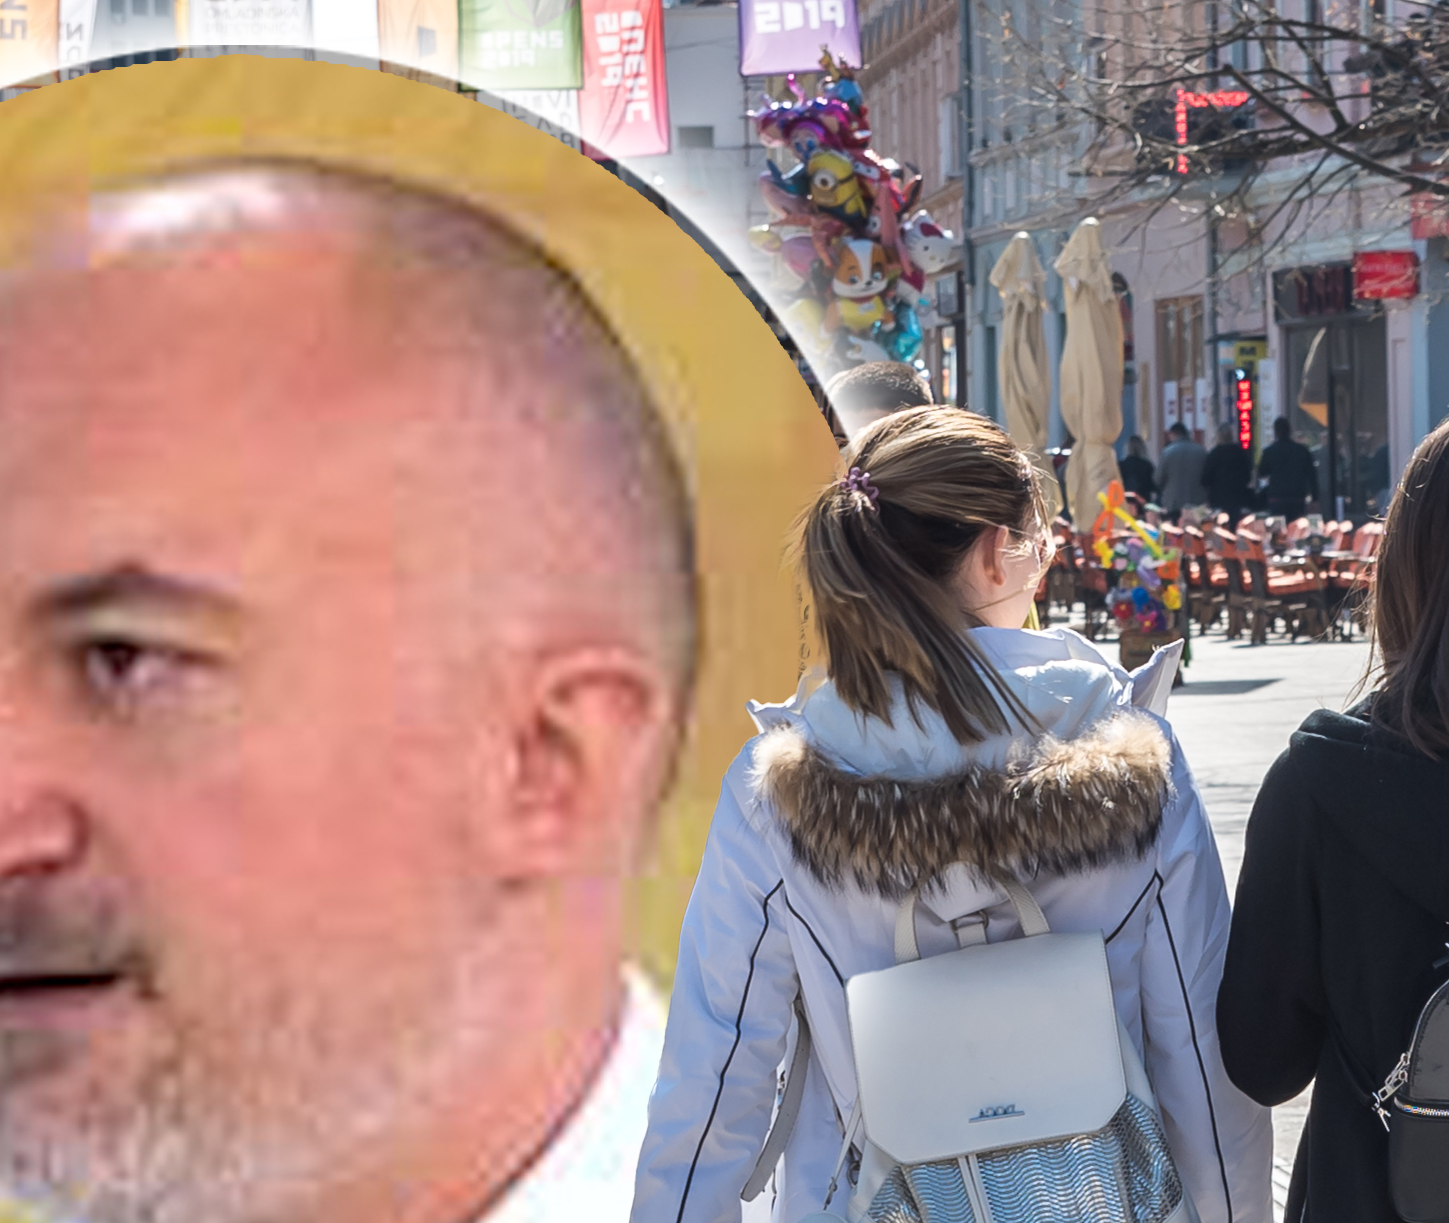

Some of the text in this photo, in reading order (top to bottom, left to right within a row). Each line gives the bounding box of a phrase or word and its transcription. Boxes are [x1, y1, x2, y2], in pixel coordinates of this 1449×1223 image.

[753, 0, 846, 34] 2019
[480, 29, 564, 49] OPENS
[593, 12, 623, 88] 2019
[480, 48, 536, 69] 2019
